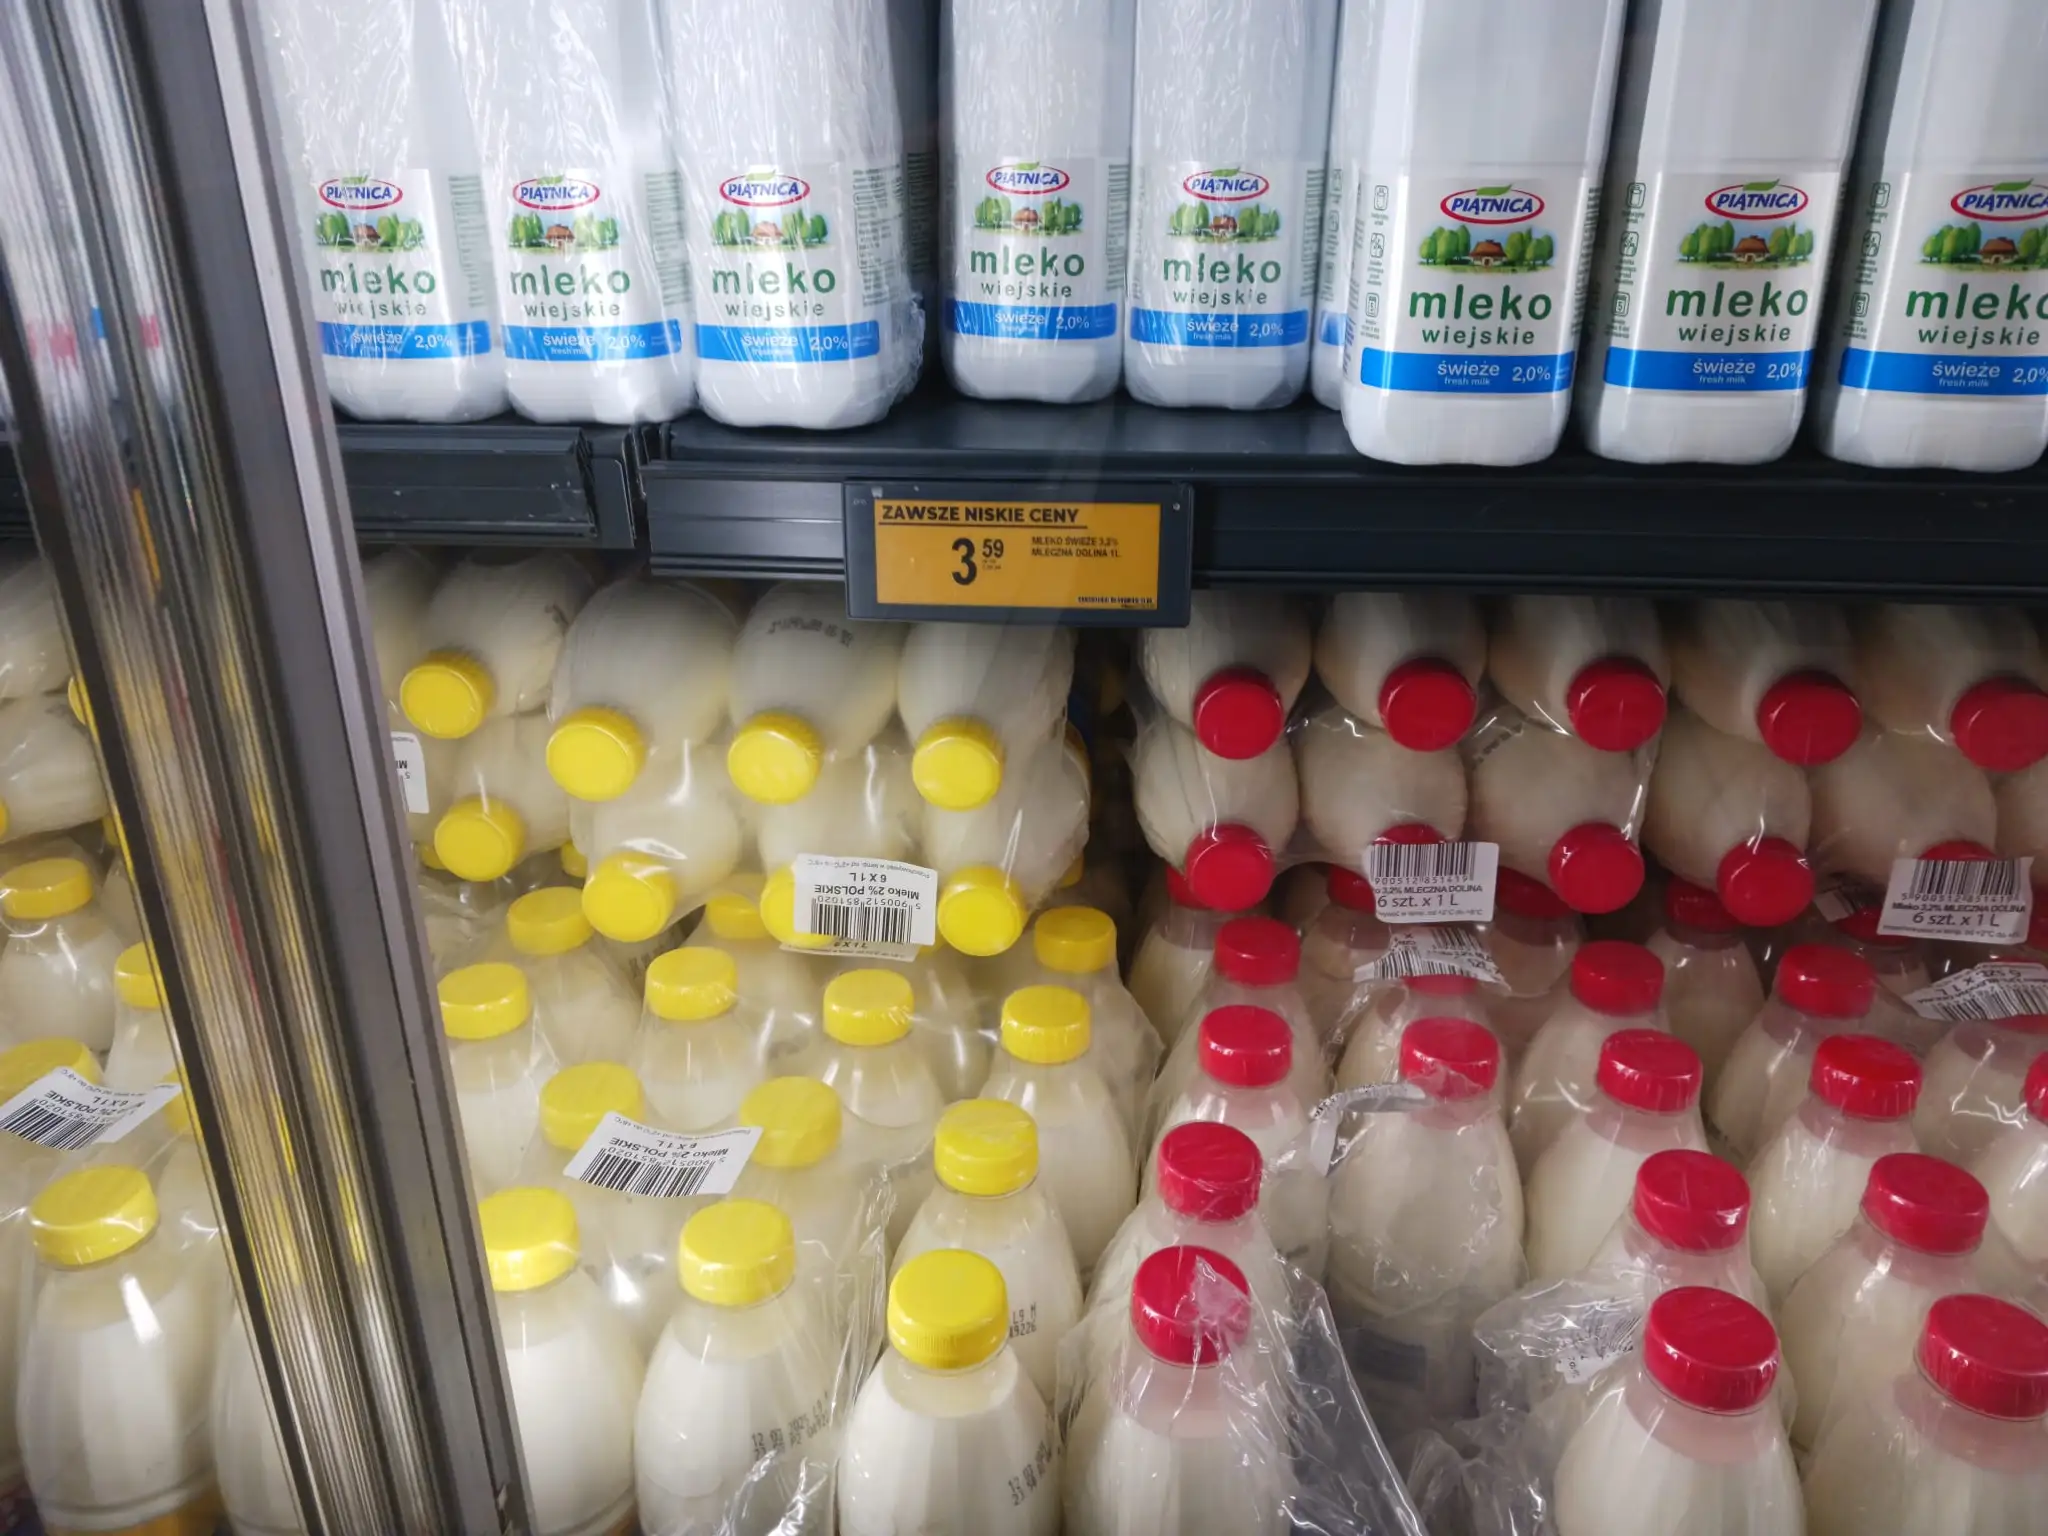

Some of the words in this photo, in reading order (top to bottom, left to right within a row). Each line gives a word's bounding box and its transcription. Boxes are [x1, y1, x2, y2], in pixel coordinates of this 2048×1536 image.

[728, 181, 800, 199] PIĄTNICA
[1451, 197, 1533, 215] PIĄTNICA
[1716, 192, 1798, 211] PIĄTNICA
[970, 247, 1085, 277] mleko
[1163, 253, 1281, 284] mleko
[321, 263, 436, 295] mleko
[511, 264, 631, 296] mleko
[712, 262, 836, 294] mleko
[981, 281, 1072, 301] wiejskie
[1174, 289, 1267, 309] wiejskie
[1666, 281, 1808, 317] mleko
[525, 301, 620, 321] wiejskie
[726, 301, 825, 321] wiejskie
[1409, 284, 1552, 321] mleko
[1056, 316, 1090, 330] 2,0%
[1249, 323, 1284, 338] 2,0%
[1421, 326, 1535, 348] wiejskie
[1678, 323, 1791, 346] wiejskie
[1917, 325, 2040, 349] wiejskie
[1437, 360, 1500, 376] świeże
[1512, 366, 1551, 383] 2,0%
[1692, 359, 1756, 374] świeże
[1766, 363, 1803, 379] 2,0%
[1932, 360, 2001, 378] świeże
[882, 504, 960, 522] ZAWSZE
[964, 505, 1025, 523] NISKIE
[1029, 507, 1079, 524] CENY
[1031, 536, 1063, 546] MLEKO
[951, 537, 978, 586] 3
[982, 538, 1005, 558] 59
[1031, 548, 1073, 558] MLECZNA
[1075, 548, 1107, 558] DOLINA
[849, 872, 857, 881] L
[880, 874, 887, 882] 6
[814, 884, 865, 895] POLSKIE
[868, 886, 885, 896] 2%
[887, 886, 919, 900] Mleko
[817, 895, 860, 906] 851020
[866, 898, 908, 908] 900512
[1377, 895, 1387, 907] 6
[1392, 896, 1418, 907] szt.
[1421, 897, 1431, 907] x
[1437, 894, 1443, 906] 1
[1450, 894, 1459, 906] L
[1892, 902, 1919, 910] Mleko
[1920, 903, 1942, 911] 3,2%
[1944, 904, 1989, 912] MLECZNA
[1991, 905, 2026, 913] DOLINA
[1912, 912, 1924, 924] 6
[1928, 914, 1956, 926] szt.
[1962, 916, 1970, 926] x
[1977, 913, 1983, 926] 1
[1990, 914, 2000, 927] L
[44, 1089, 98, 1113] POLSKIE
[608, 1137, 667, 1158] POLSKIE
[656, 1139, 666, 1147] L
[693, 1148, 729, 1158] Mleko
